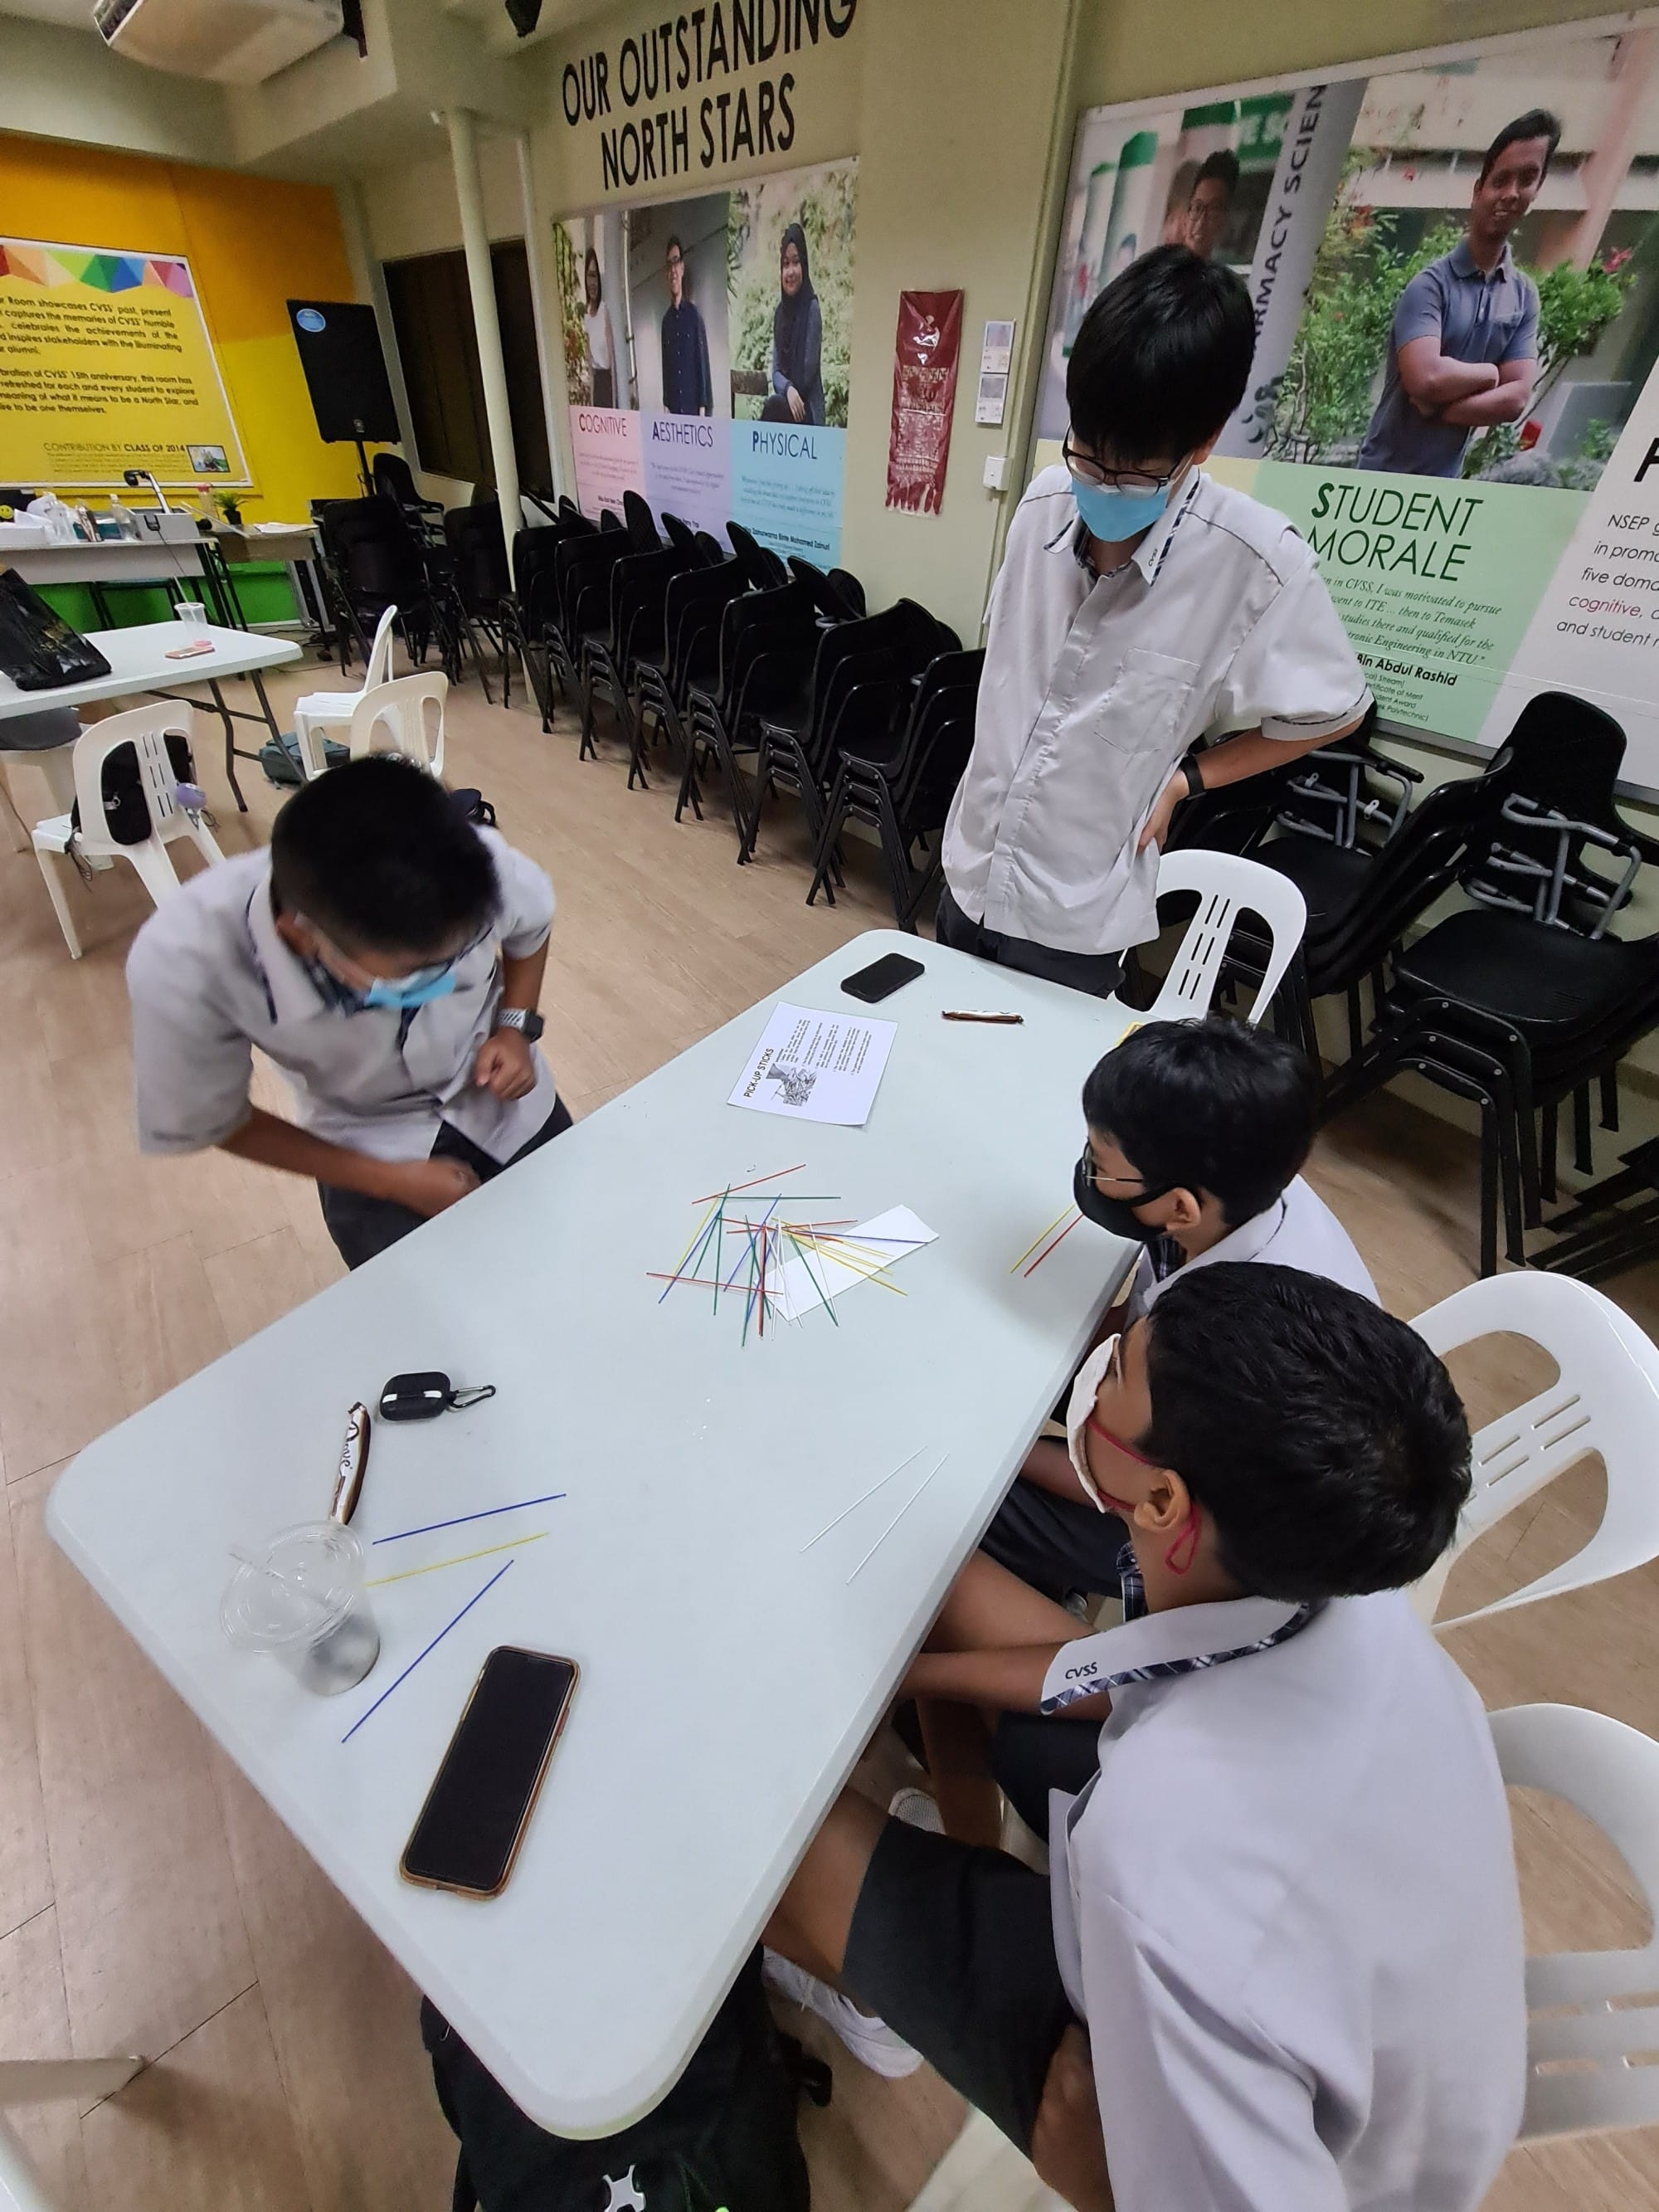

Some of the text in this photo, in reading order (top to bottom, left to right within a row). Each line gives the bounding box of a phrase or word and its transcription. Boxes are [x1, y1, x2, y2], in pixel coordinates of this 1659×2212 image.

[562, 0, 858, 126] OUR OUTSTANDING
[601, 72, 795, 191] NORTH STARS
[7, 295, 36, 307] Room
[37, 299, 87, 311] showcases
[140, 308, 172, 317] present
[4, 310, 46, 320] captures
[46, 312, 61, 320] the
[62, 314, 107, 324] memories
[108, 315, 116, 324] of
[143, 319, 175, 329] humble
[11, 322, 60, 333] celebrates
[65, 324, 80, 334] the
[85, 327, 147, 339] achievements
[164, 331, 178, 340] the
[7, 333, 42, 343] inspires
[43, 335, 100, 347] stakeholders
[101, 339, 119, 348] with
[119, 339, 134, 349] the
[134, 339, 182, 353] illuminating
[33, 369, 42, 378] of
[70, 370, 90, 380] 15th
[140, 374, 155, 383] this
[155, 376, 178, 384] room
[178, 376, 192, 384] has
[38, 392, 47, 400] of
[49, 393, 71, 402] what
[71, 393, 78, 402] it
[80, 395, 109, 403] means
[109, 395, 119, 403] to
[119, 395, 133, 403] be
[140, 396, 163, 405] North
[182, 397, 199, 406] and
[43, 381, 56, 390] for
[57, 382, 80, 392] each
[100, 385, 123, 393] every
[125, 385, 155, 394] student
[155, 386, 165, 394] to
[166, 387, 196, 396] explore
[13, 402, 23, 412] to
[24, 402, 37, 412] be
[39, 404, 56, 412] one
[578, 412, 628, 437] COGNITIVE
[651, 420, 713, 448] AESTHETICS
[43, 441, 186, 452] CONTRIBUTION BY CLASS OF 2014
[752, 430, 818, 460] PHYSICAL
[1311, 482, 1484, 537] STUDENT
[1607, 514, 1651, 531] NSEP
[1306, 524, 1472, 582] MORALE
[1593, 540, 1608, 555] in
[1581, 567, 1610, 583] five
[1334, 576, 1344, 587] in
[1375, 583, 1384, 594] I
[1384, 587, 1402, 598] was
[1404, 591, 1457, 607] motivated
[1455, 600, 1465, 609] to
[1462, 602, 1502, 615] pursue
[1354, 599, 1364, 608] to
[1365, 598, 1388, 612] ITE
[1397, 605, 1420, 619] then
[1421, 611, 1432, 621] to
[1433, 611, 1477, 630] Temasek
[1569, 596, 1642, 618] cognitive,
[1340, 613, 1494, 650] studies there and qualified for the
[1556, 621, 1590, 635] and
[1588, 625, 1652, 646] student
[1374, 634, 1432, 659] Engineering
[1433, 646, 1445, 658] in
[1374, 657, 1413, 676] Abdul
[1414, 666, 1458, 686] Rashid
[1393, 698, 1417, 709] Award
[742, 1048, 775, 1099] PICK-UP STICKS
[1064, 1661, 1099, 1681] CVSS
